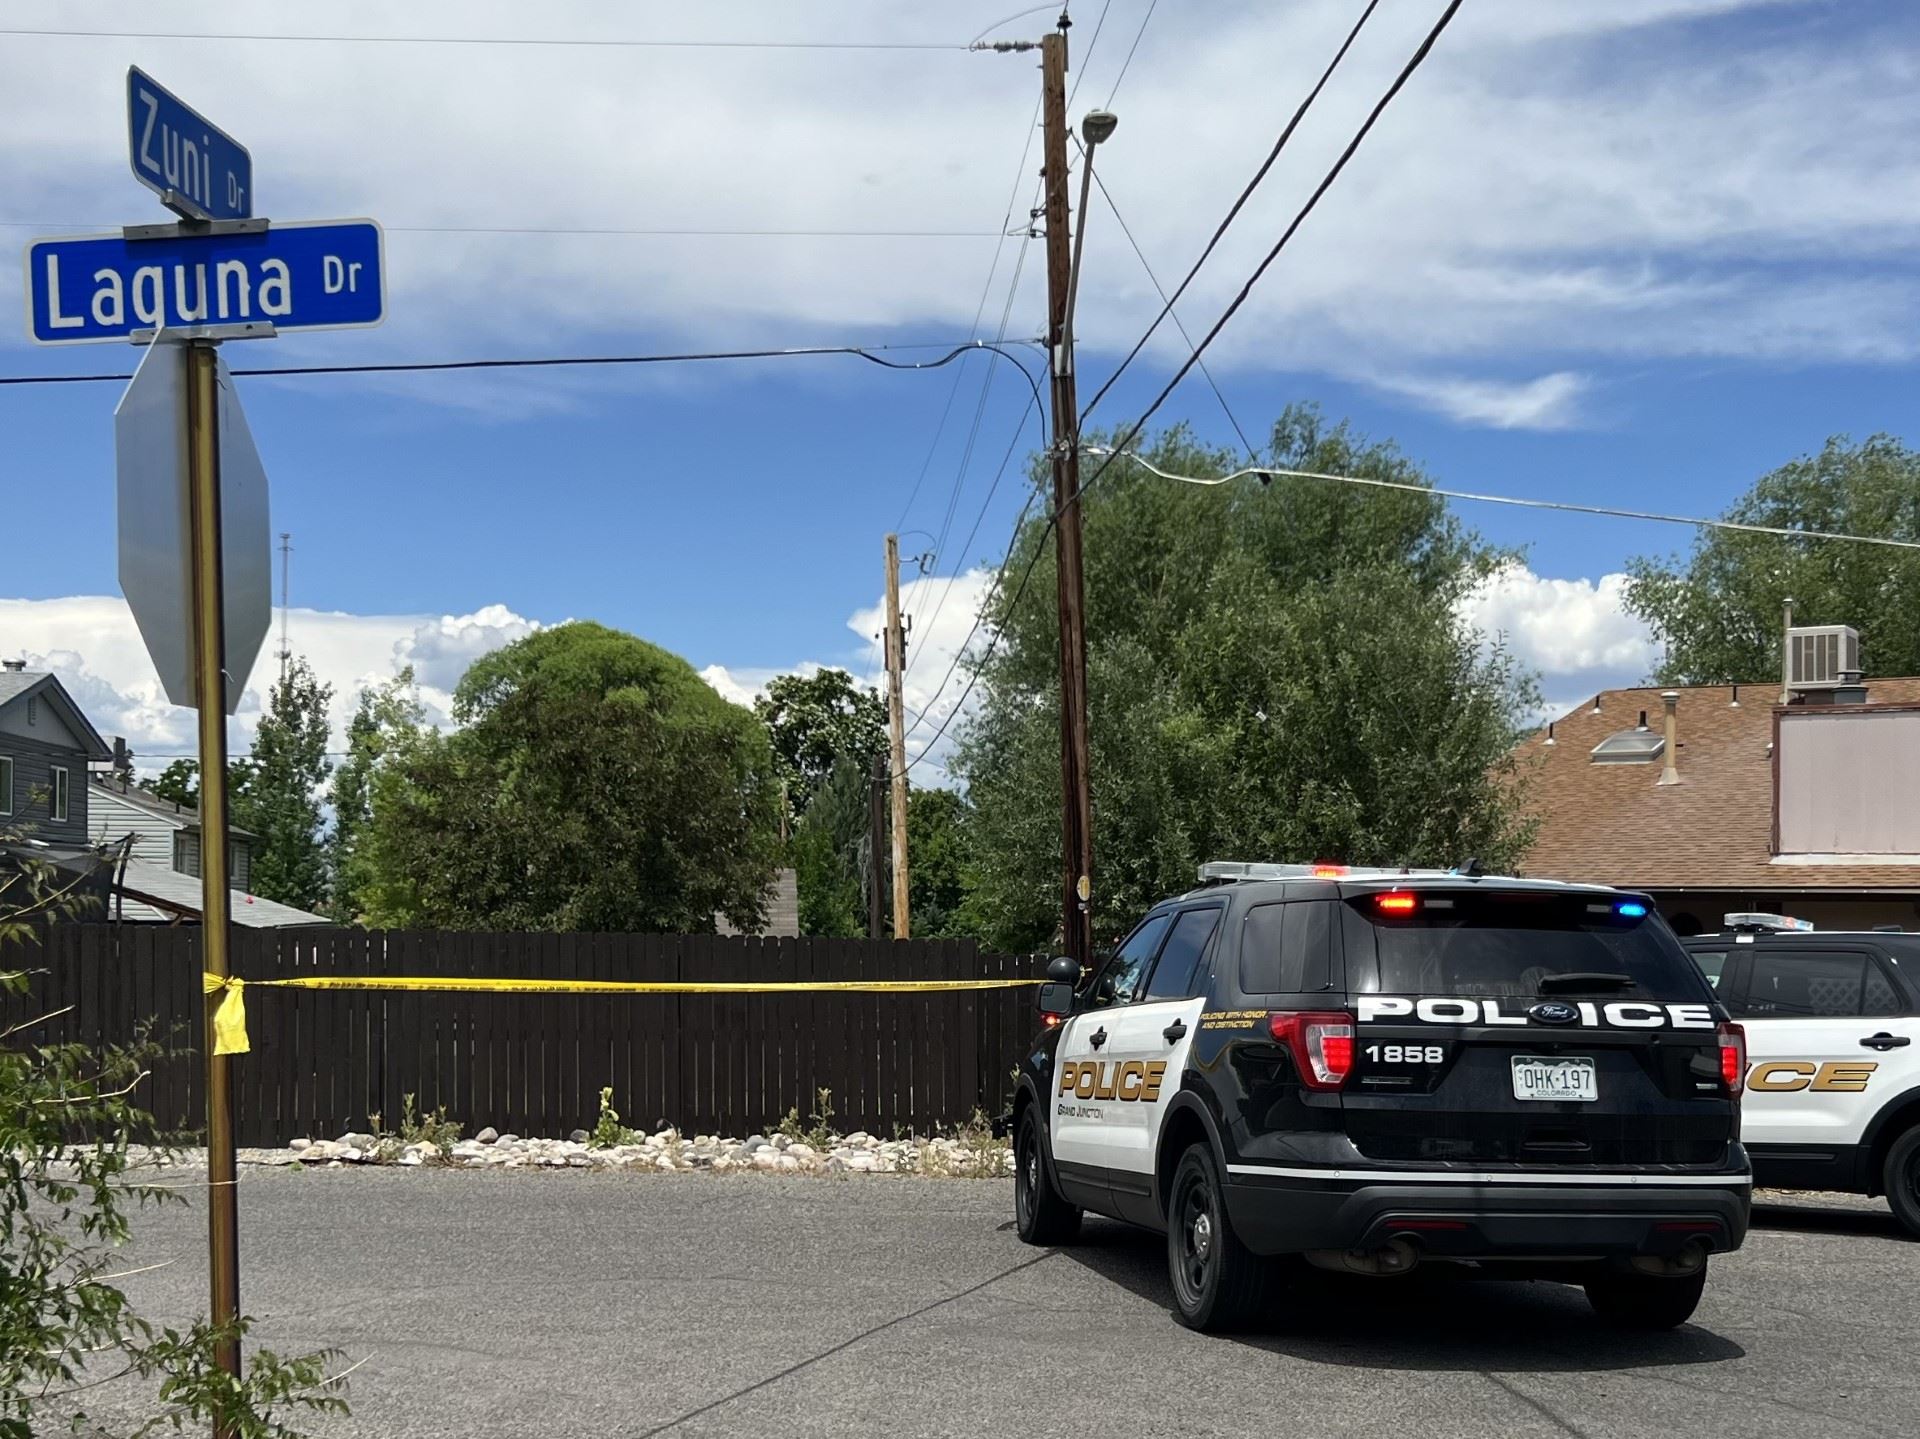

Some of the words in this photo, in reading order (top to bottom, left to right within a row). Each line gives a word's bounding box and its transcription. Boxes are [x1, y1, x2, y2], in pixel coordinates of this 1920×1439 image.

[140, 87, 211, 208] Zuni
[227, 170, 244, 214] Dr
[47, 253, 292, 329] Laguna
[323, 255, 362, 294] Dr
[1202, 1021, 1216, 1029] AND
[1357, 997, 1715, 1029] POLICE
[1541, 1005, 1568, 1018] Ford
[1365, 1045, 1444, 1063] 1858
[1058, 1061, 1168, 1102] POLICE
[1744, 1061, 1879, 1092] CE
